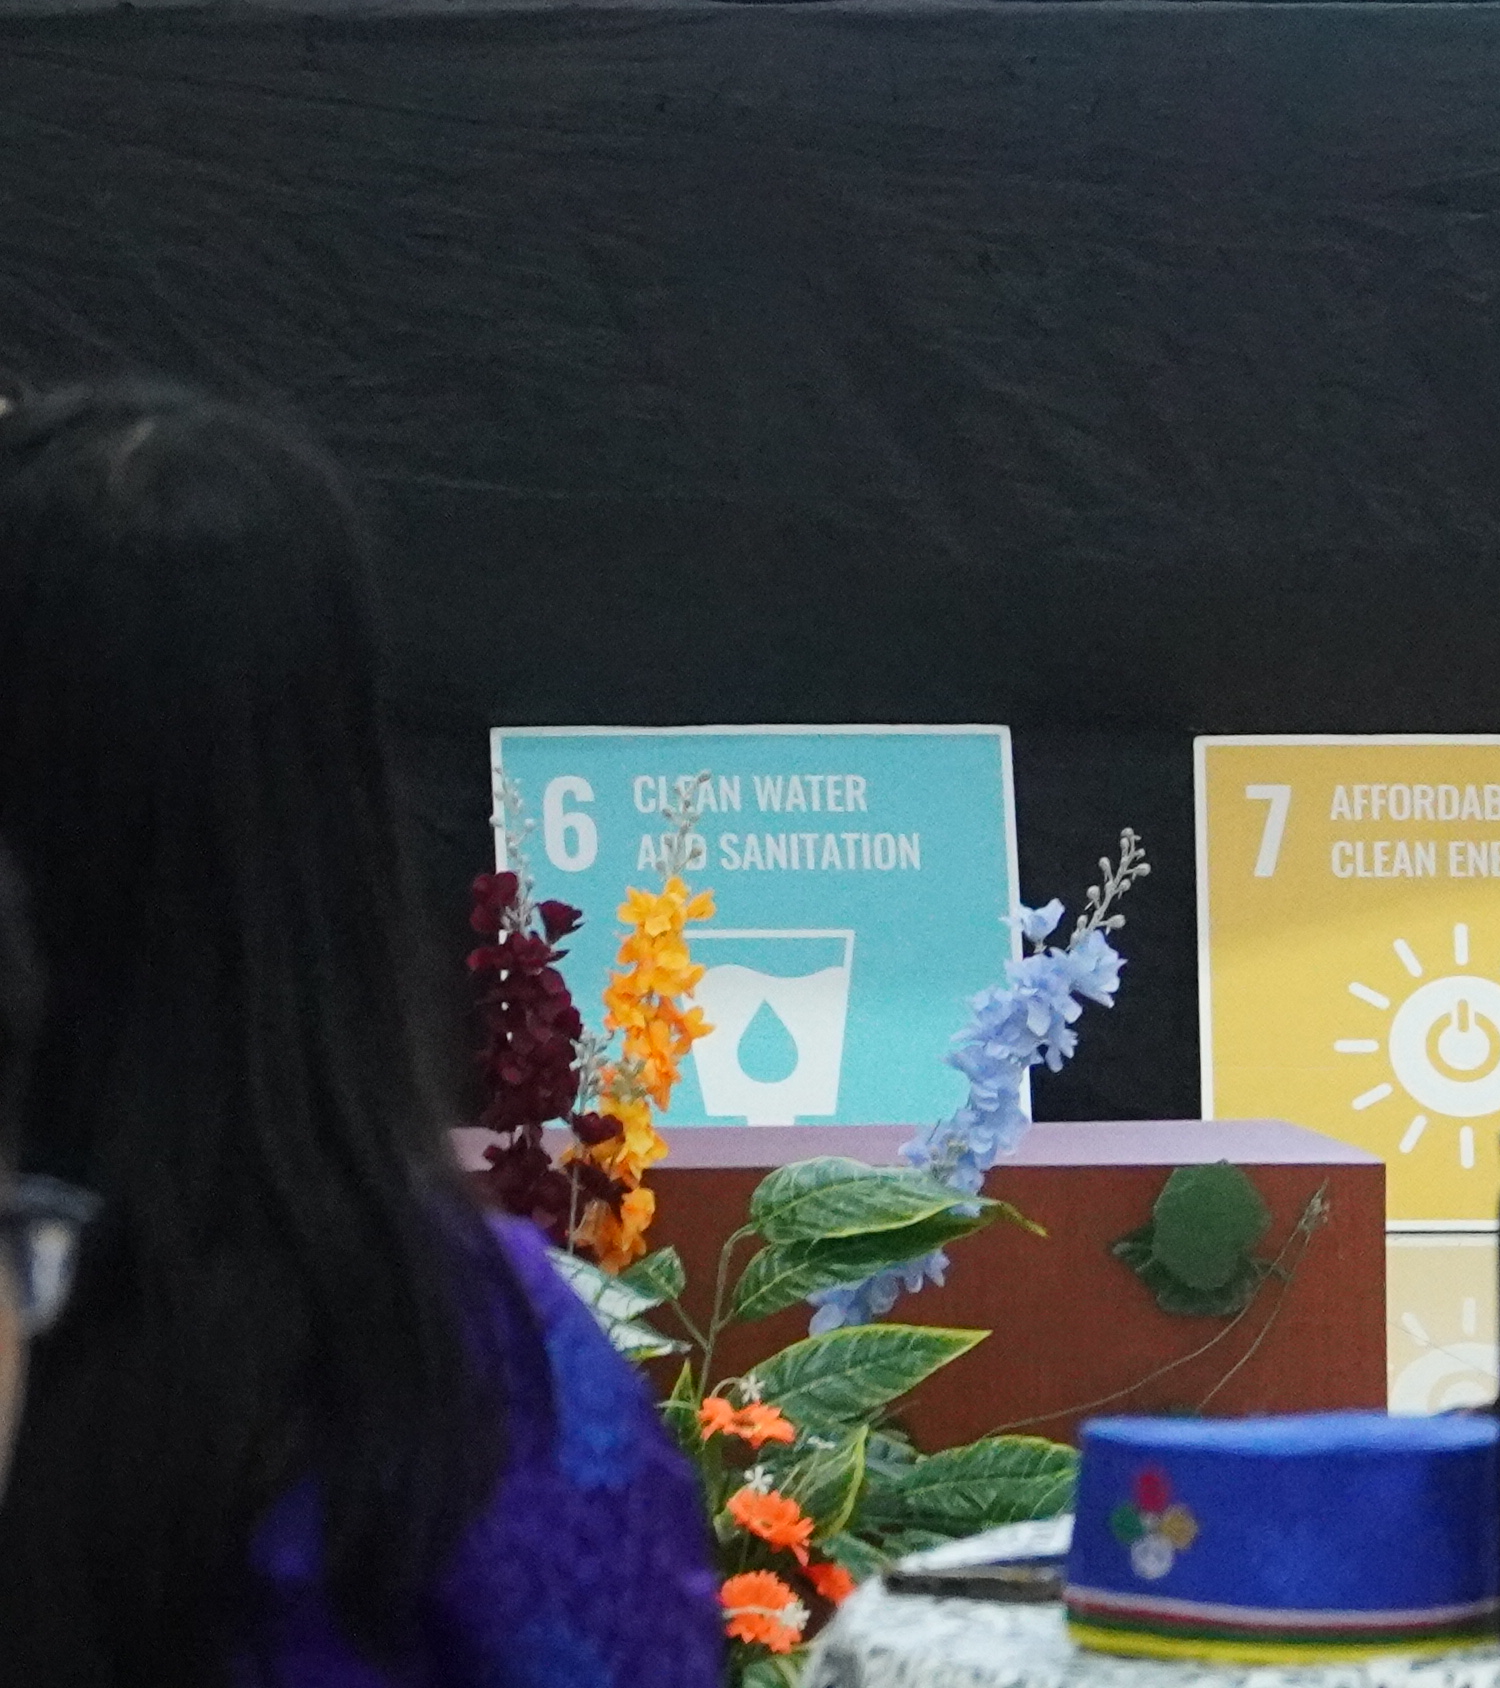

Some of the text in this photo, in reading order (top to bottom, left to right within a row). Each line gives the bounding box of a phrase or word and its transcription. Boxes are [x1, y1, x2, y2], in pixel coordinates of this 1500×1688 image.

[542, 774, 868, 872] 6 CLEAN WATER
[720, 832, 921, 871] SANITATION
[1245, 784, 1291, 878] 7
[1331, 841, 1436, 878] CLEAN
